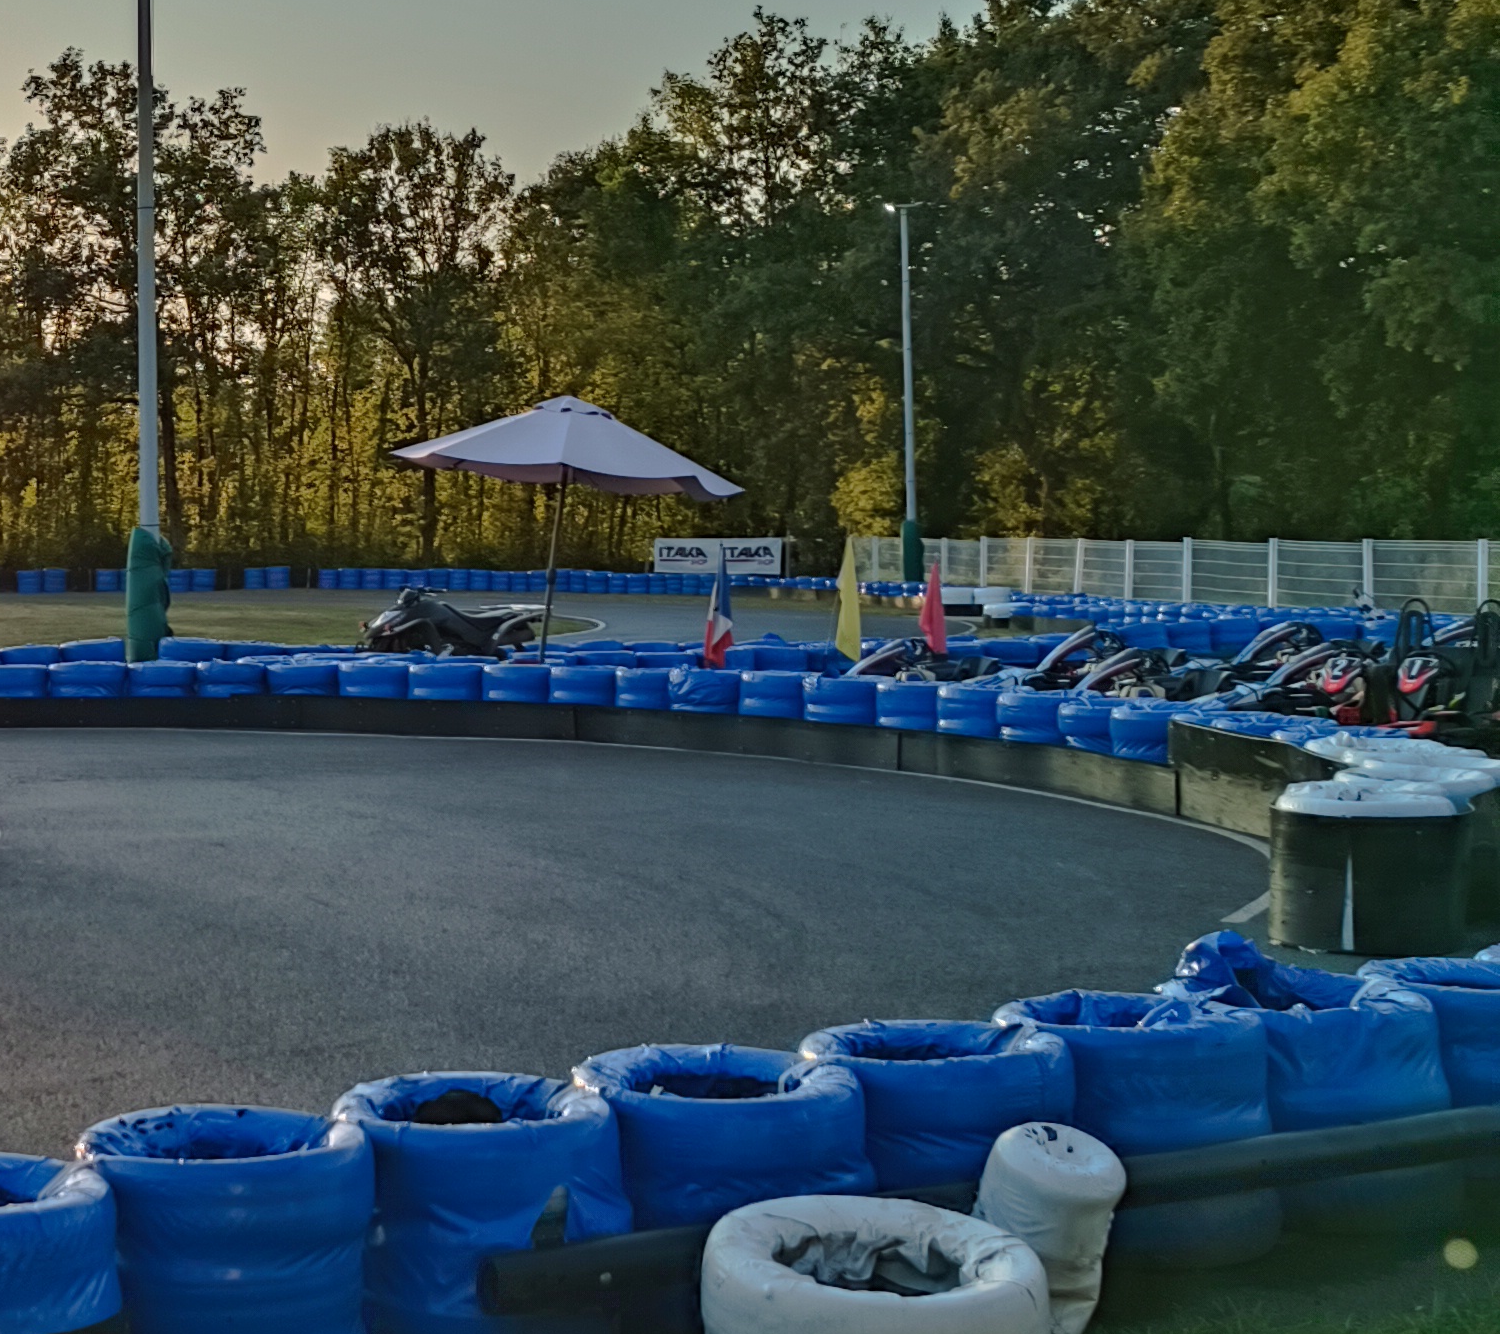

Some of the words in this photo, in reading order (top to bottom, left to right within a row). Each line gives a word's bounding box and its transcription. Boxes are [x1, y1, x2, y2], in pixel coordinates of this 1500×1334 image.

[659, 546, 708, 558] ITAKA
[1332, 659, 1348, 676] 2
[1410, 659, 1422, 676] 1
